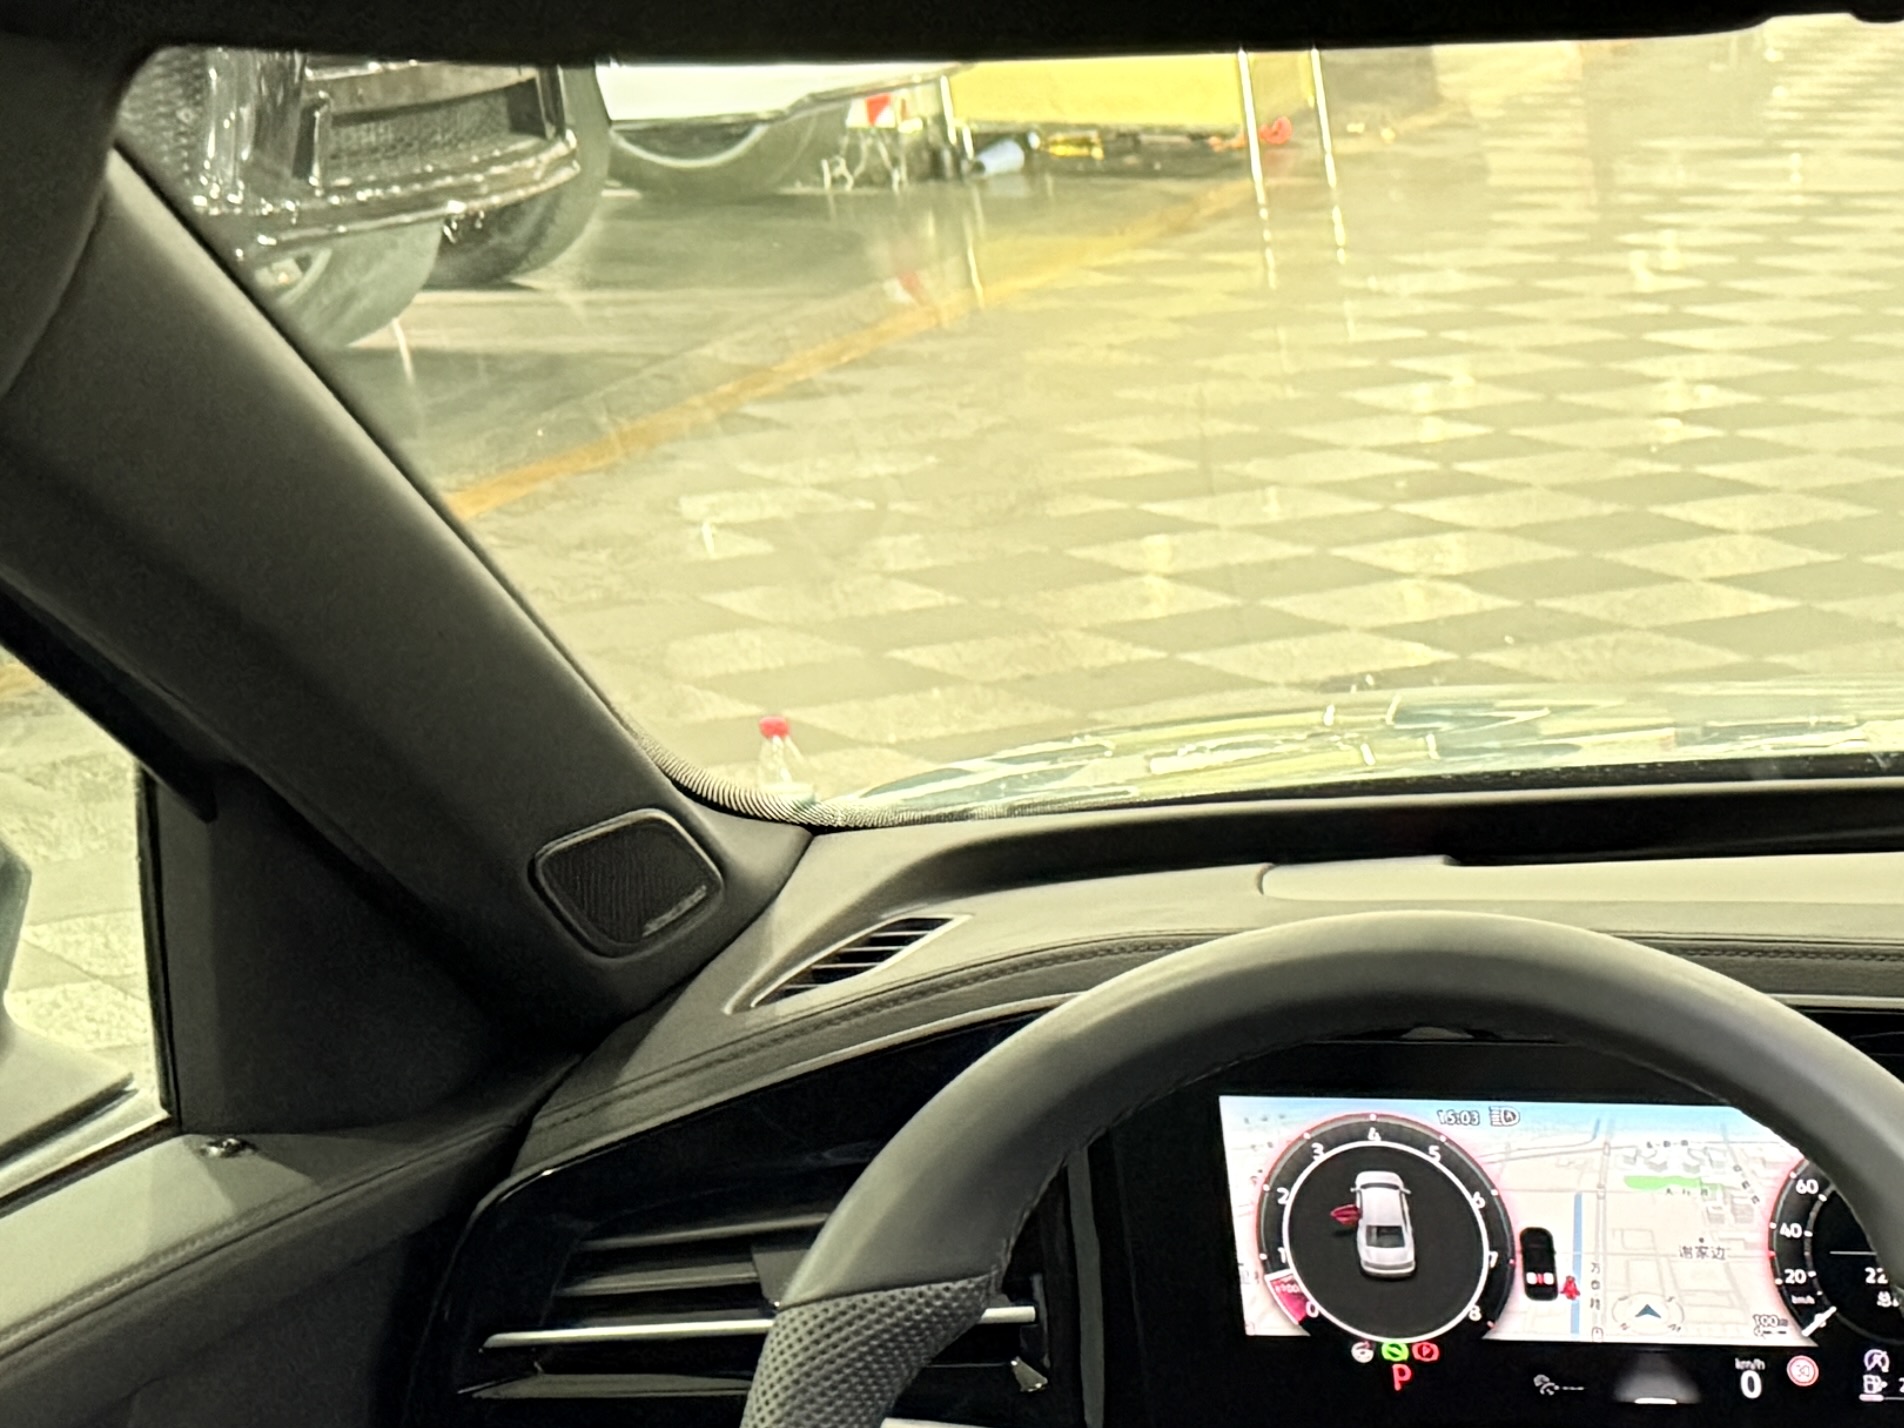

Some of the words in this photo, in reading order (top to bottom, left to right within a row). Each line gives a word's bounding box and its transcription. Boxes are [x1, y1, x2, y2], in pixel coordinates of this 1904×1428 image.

[1436, 1108, 1481, 1127] 15:03
[1312, 1142, 1325, 1157] 3
[1428, 1145, 1441, 1162] 5
[1796, 1179, 1819, 1195] 60
[1276, 1187, 1290, 1205] 2
[1472, 1191, 1486, 1209] 6
[1779, 1223, 1803, 1239] 40
[1784, 1269, 1807, 1285] 20
[1305, 1300, 1320, 1319] 0
[1468, 1305, 1483, 1322] 8
[1735, 1358, 1765, 1371] km/h
[1393, 1364, 1412, 1391] P
[1740, 1371, 1762, 1399] 0
